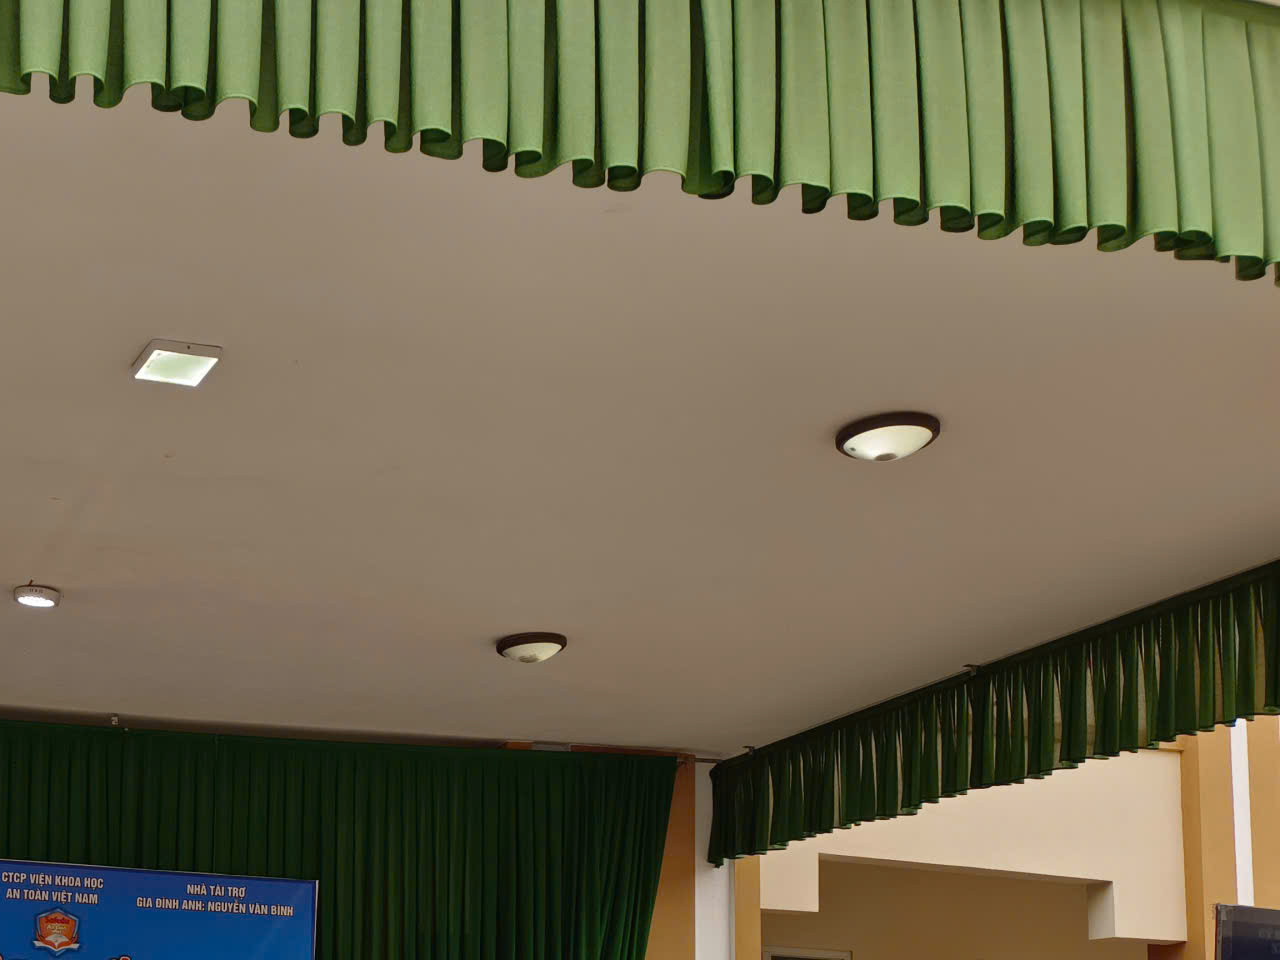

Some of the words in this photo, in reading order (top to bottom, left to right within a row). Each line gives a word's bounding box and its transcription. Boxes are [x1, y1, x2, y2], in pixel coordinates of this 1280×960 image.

[1, 871, 27, 883] CTCP
[30, 873, 52, 887] VIỆN
[55, 875, 81, 887] KHOA
[84, 877, 104, 891] HỌC
[6, 888, 20, 899] AN
[23, 888, 49, 901] TOÀN
[52, 890, 72, 904] VIỆT
[75, 893, 98, 904] NAM
[186, 883, 207, 896] NHÀ
[209, 883, 224, 897] TÀI
[228, 886, 247, 900] TRỢ
[136, 896, 152, 908] GIA
[155, 897, 179, 910] ĐÌNH
[182, 900, 205, 912] ANH:
[271, 903, 294, 917] BÌNH
